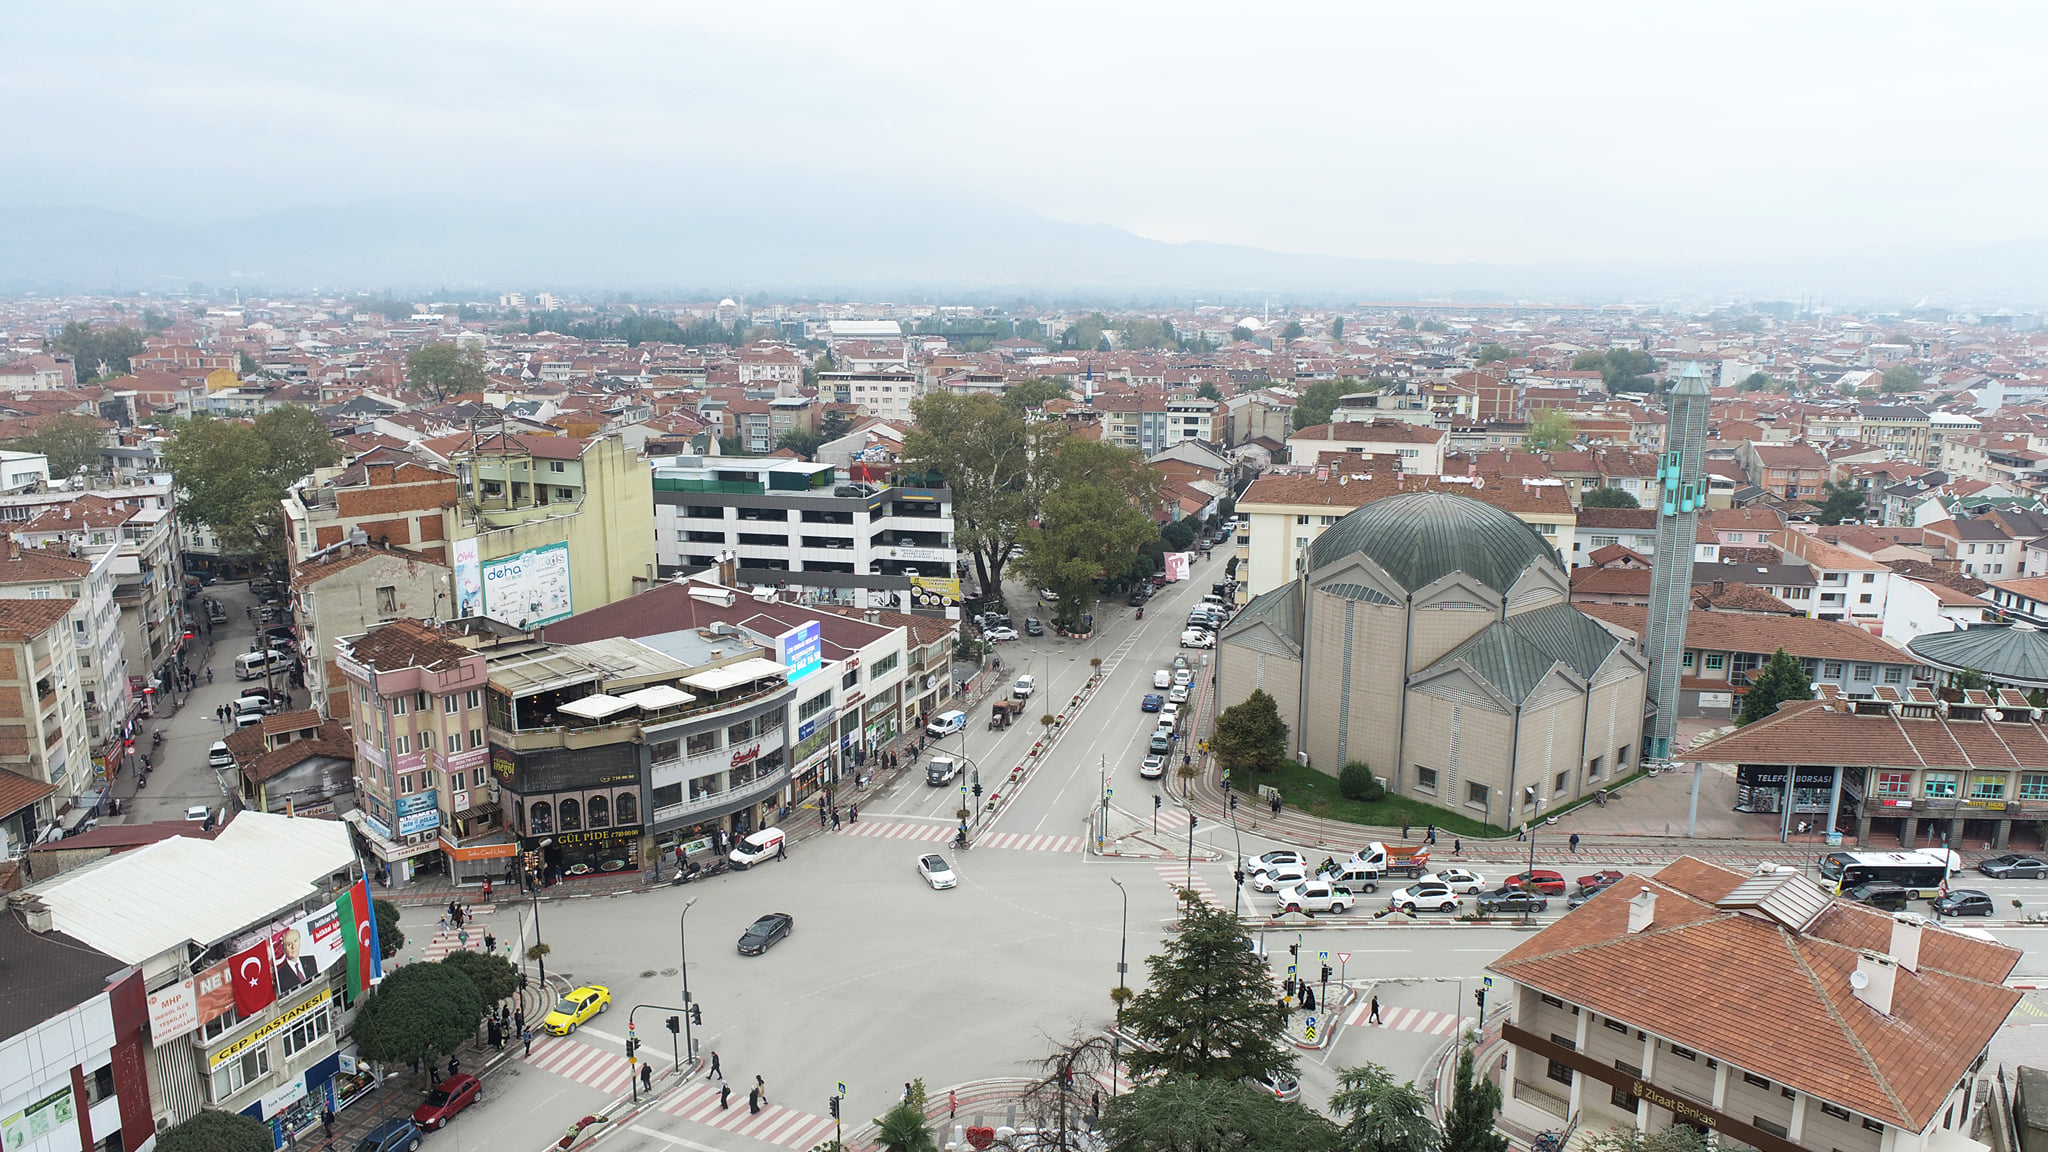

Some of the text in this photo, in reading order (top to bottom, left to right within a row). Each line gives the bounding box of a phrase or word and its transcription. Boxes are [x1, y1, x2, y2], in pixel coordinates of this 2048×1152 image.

[487, 564, 522, 581] deha
[1796, 775, 1832, 783] BORSASI
[307, 806, 328, 816] Pidesi
[558, 833, 581, 844] GÜL
[583, 830, 609, 842] PİDE
[201, 972, 222, 996] NE
[161, 994, 182, 1009] MHP
[219, 993, 323, 1060] CEP HASTANESİ
[1644, 1087, 1717, 1127] Ziraat Bankası
